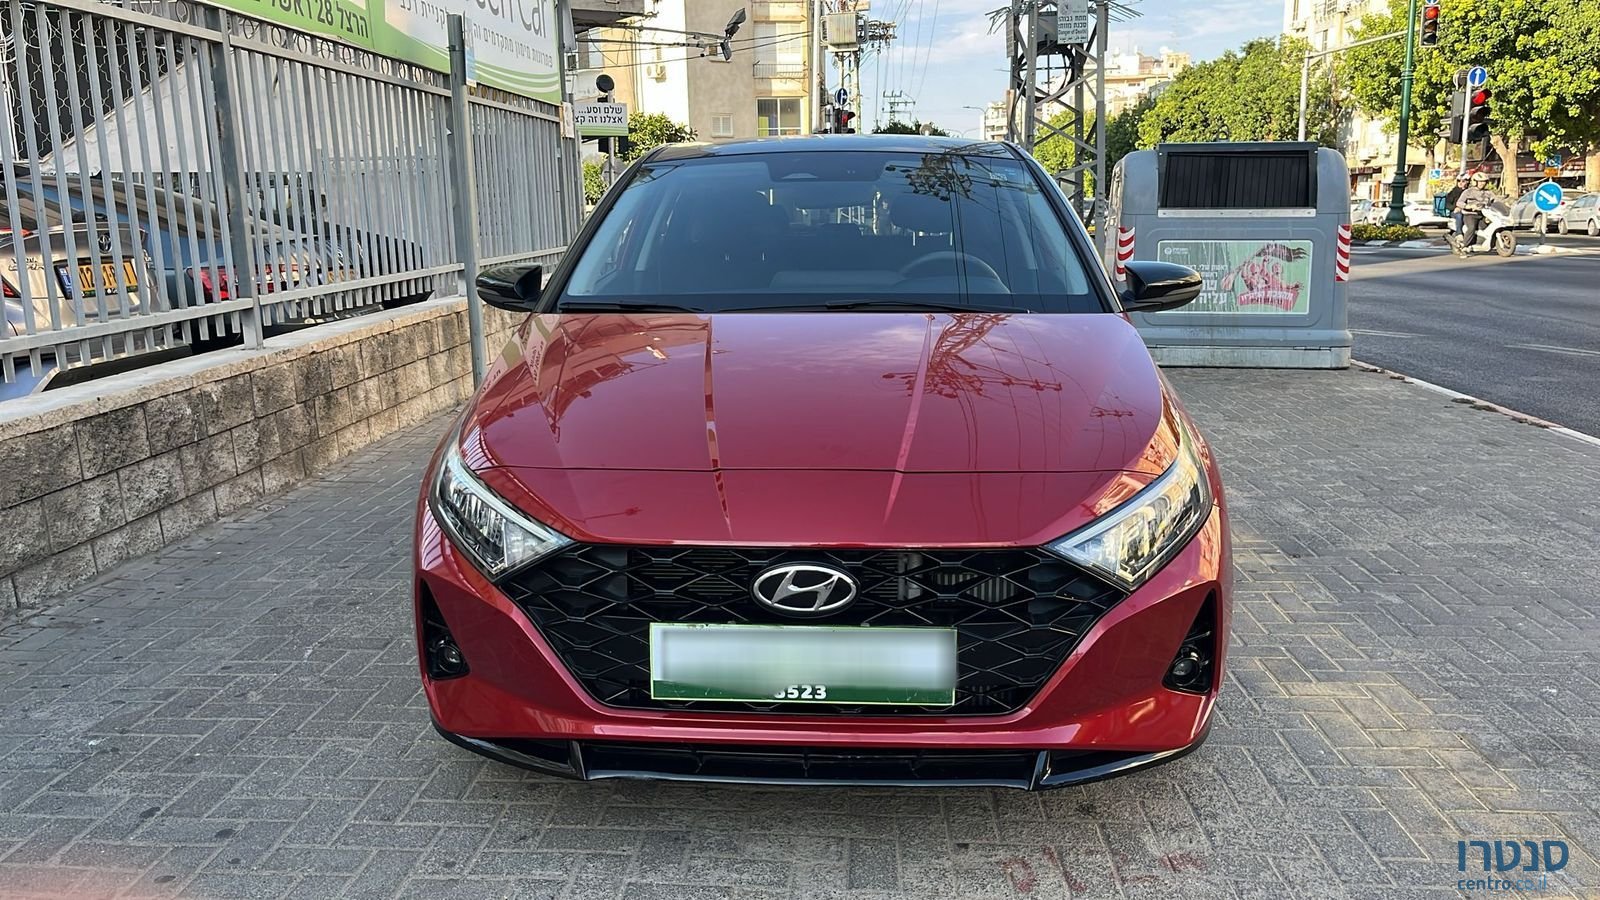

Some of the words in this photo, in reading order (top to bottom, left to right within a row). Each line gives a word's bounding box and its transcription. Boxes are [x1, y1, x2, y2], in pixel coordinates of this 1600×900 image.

[318, 0, 334, 26] 28
[336, 1, 369, 38] הרצל
[604, 105, 622, 114] שלם
[575, 115, 586, 125] קצ
[600, 115, 623, 123] אצלנו
